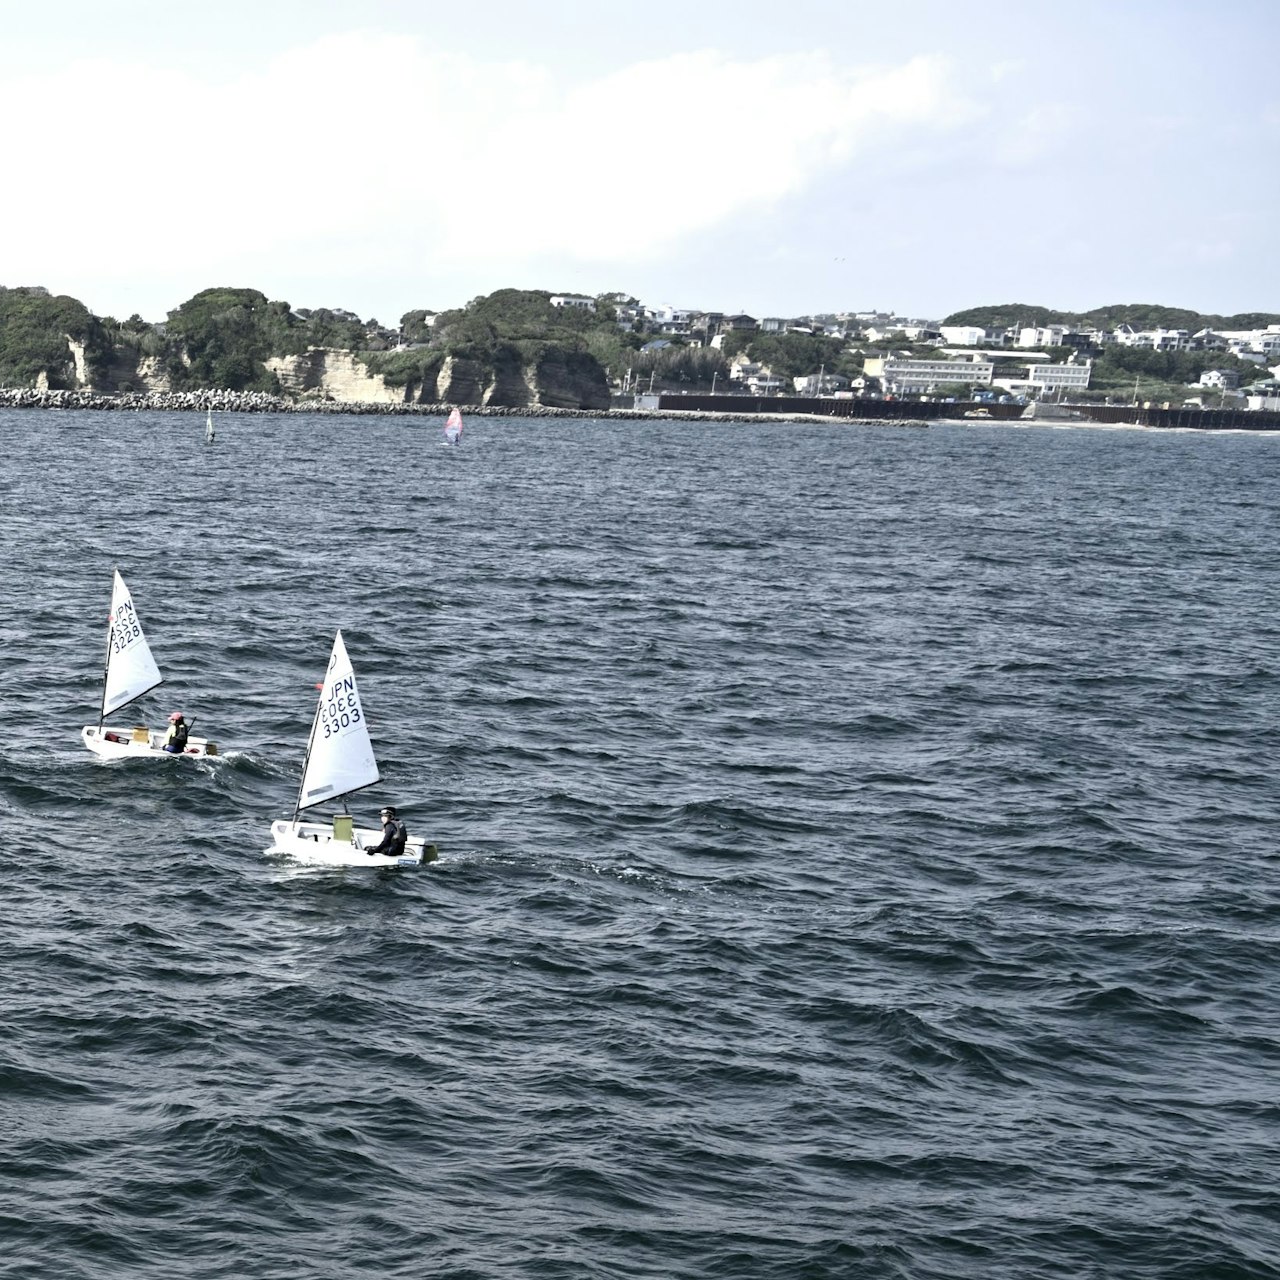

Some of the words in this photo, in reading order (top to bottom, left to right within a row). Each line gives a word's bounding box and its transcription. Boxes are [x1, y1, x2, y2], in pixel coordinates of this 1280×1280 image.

[115, 600, 132, 623] JPN
[113, 626, 140, 654] 3228
[328, 676, 353, 702] JPN
[324, 709, 360, 738] 3303
